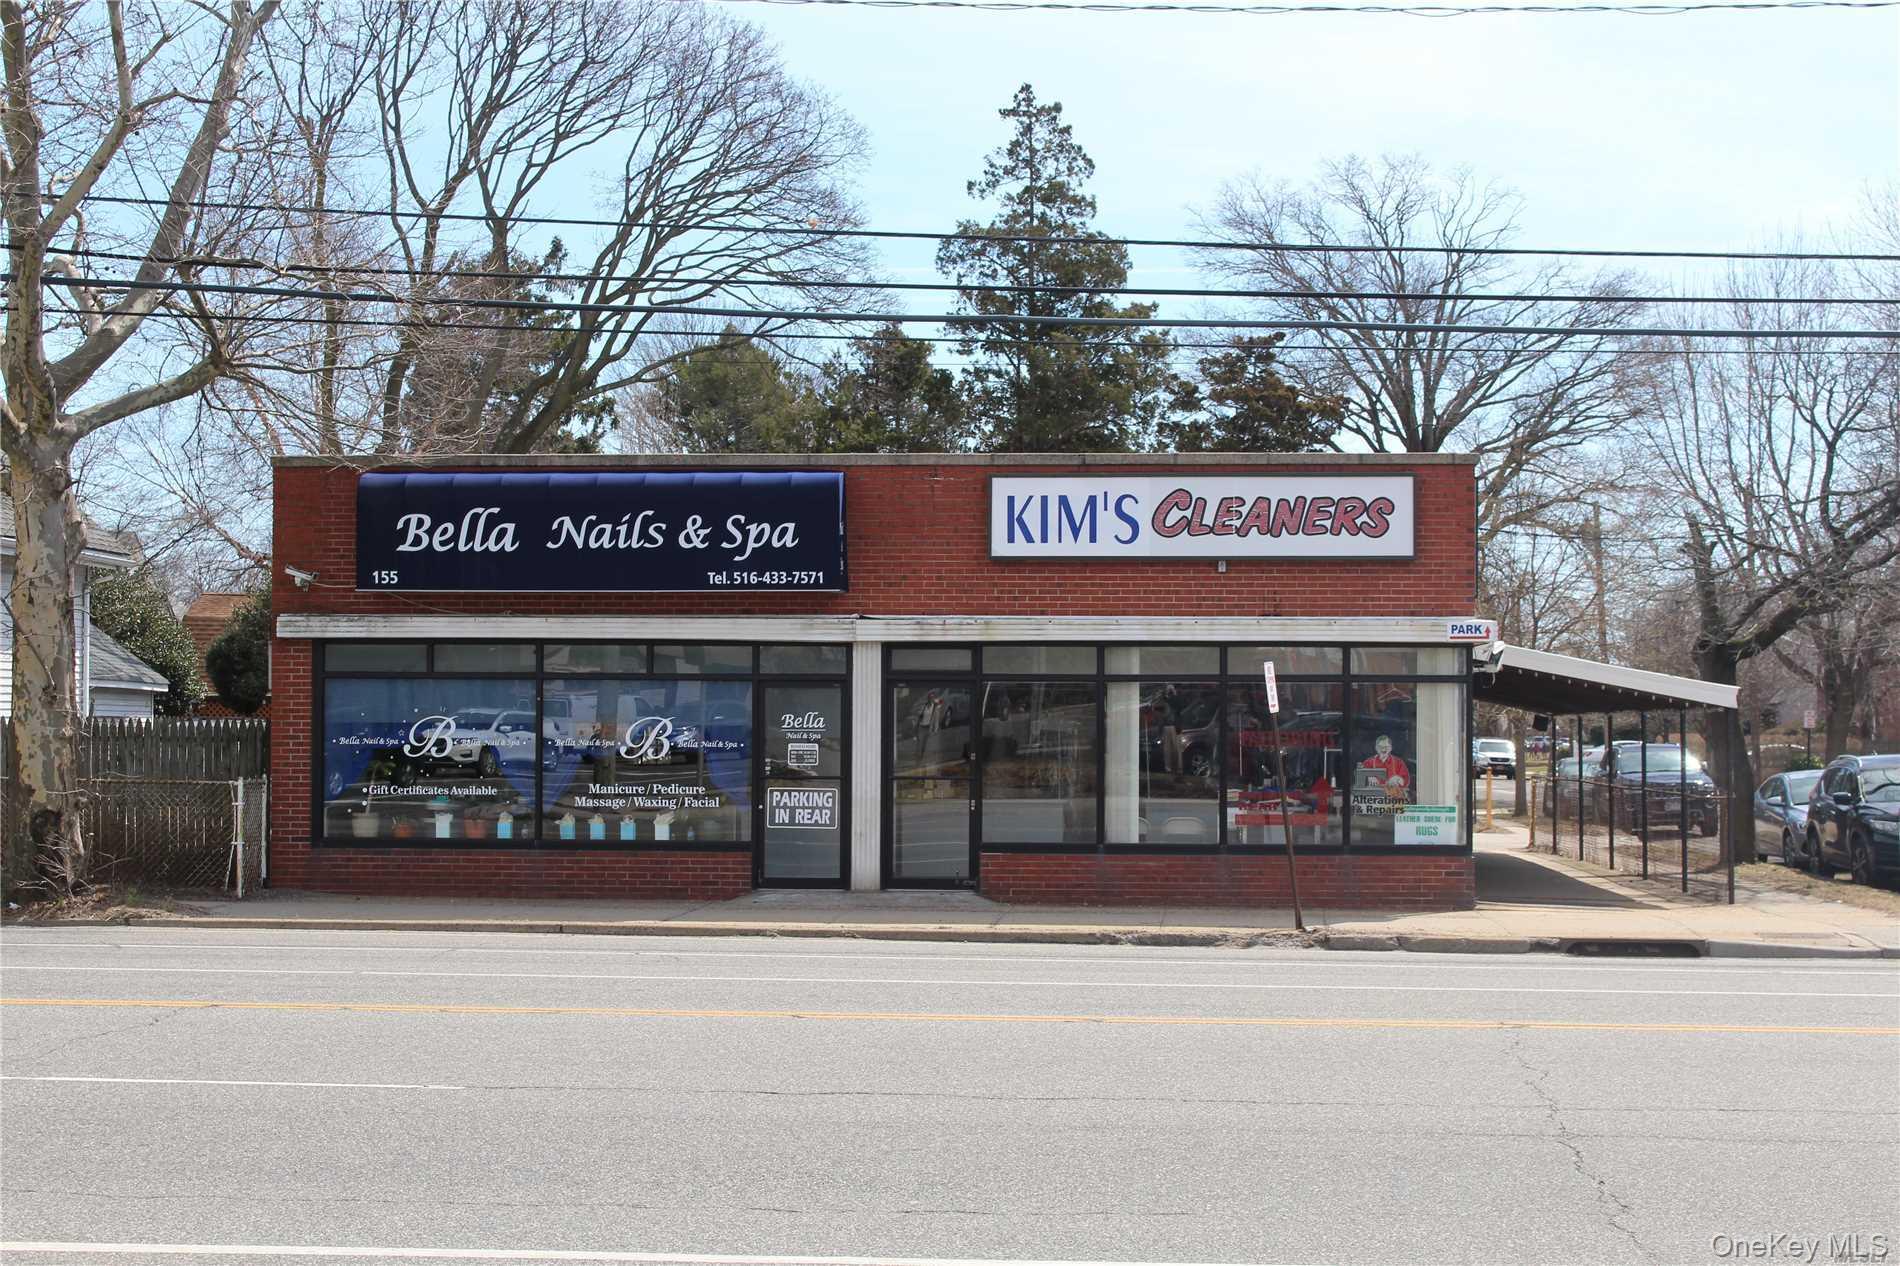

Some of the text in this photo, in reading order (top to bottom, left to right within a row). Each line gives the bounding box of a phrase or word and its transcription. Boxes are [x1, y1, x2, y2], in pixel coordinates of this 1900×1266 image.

[1006, 488, 1396, 545] KIM'S CLEANERS
[396, 507, 520, 552] Bella
[546, 510, 666, 549] Nails
[678, 514, 712, 549] &
[720, 514, 799, 561] Spa
[372, 571, 398, 584] 155
[707, 571, 824, 585] Tel. 516-433-7571
[1451, 624, 1482, 634] PARK
[780, 711, 826, 728] Bella
[339, 736, 360, 745] Bella
[361, 736, 379, 745] Nail
[386, 738, 399, 748] Spa
[554, 738, 576, 747] Bella
[678, 739, 698, 748] Bella
[724, 741, 738, 750] Spa
[368, 785, 497, 796] Gift Certificates Available
[588, 783, 646, 794] Manicure
[652, 784, 705, 795] Pedicure
[574, 796, 626, 809] Massage
[633, 797, 677, 809] Waxing
[684, 797, 720, 808] Facial
[772, 791, 833, 807] PARKING
[1352, 794, 1409, 807] Alterations
[775, 809, 831, 825] IN REAR
[1366, 805, 1405, 816] Repairs
